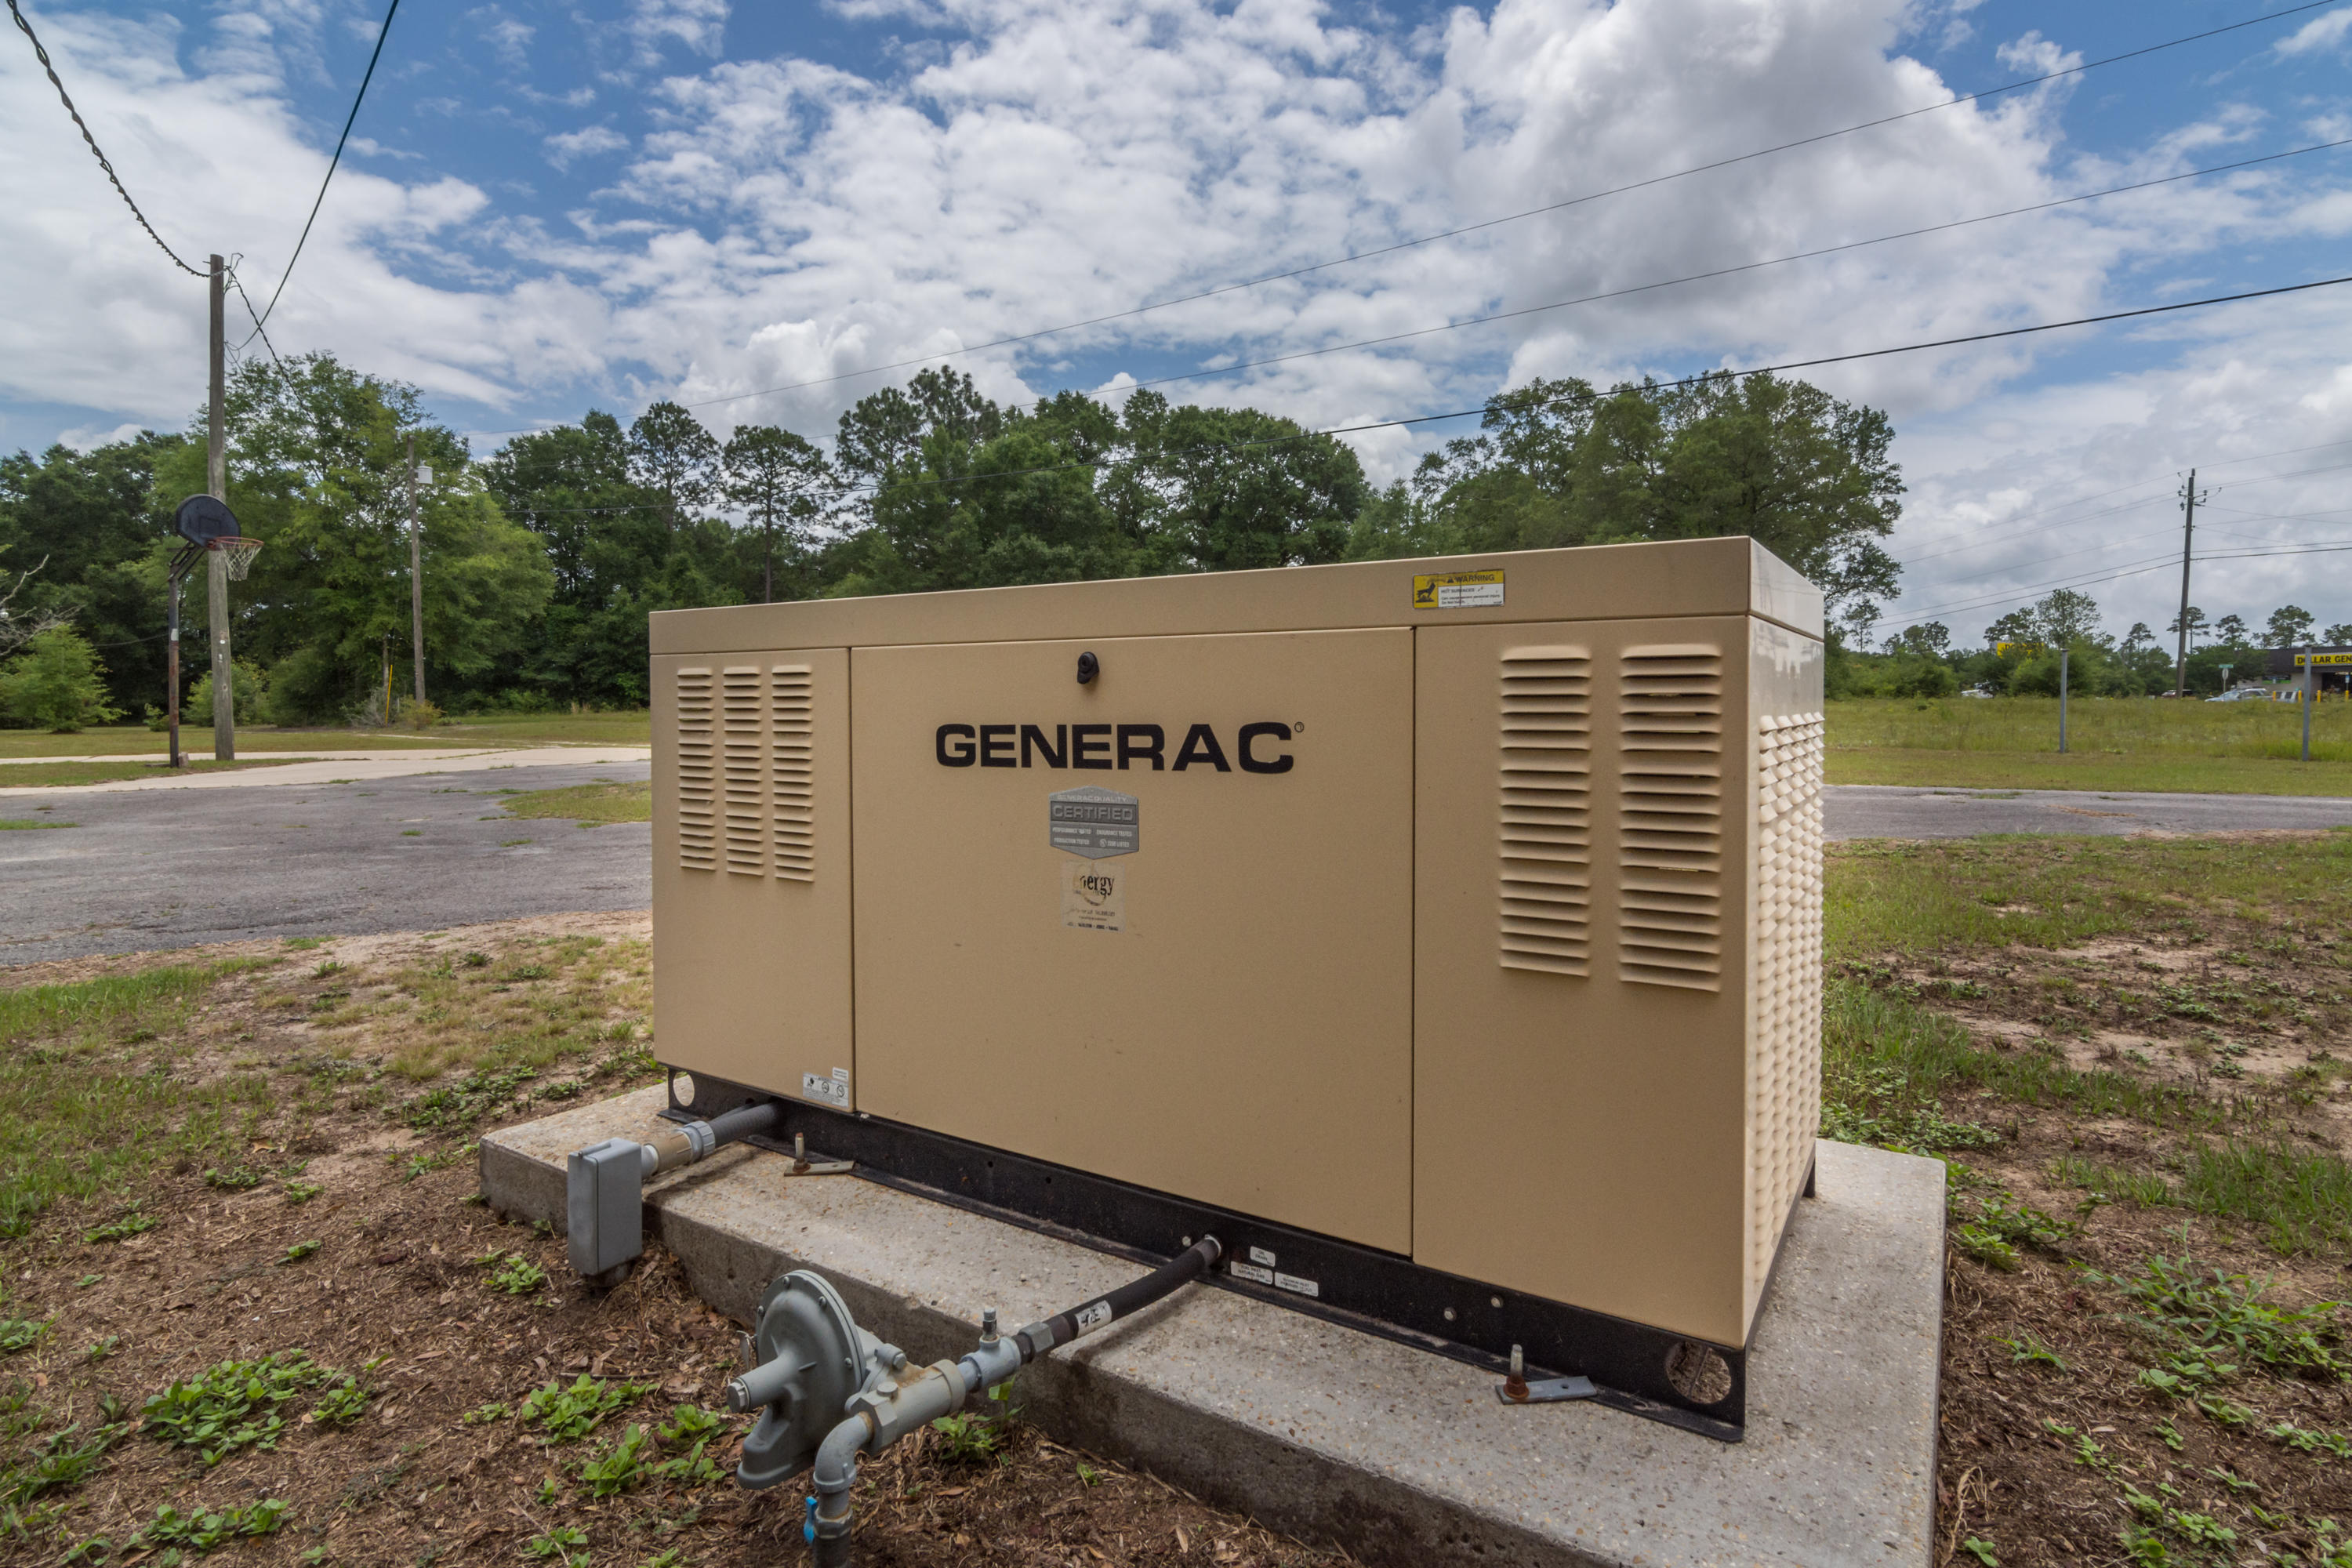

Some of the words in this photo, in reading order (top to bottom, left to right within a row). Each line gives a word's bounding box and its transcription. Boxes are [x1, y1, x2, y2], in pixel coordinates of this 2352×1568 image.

[1455, 574, 1494, 583] WARNING
[936, 721, 1294, 774] GENERAC
[1053, 804, 1133, 821] CERTIFIED
